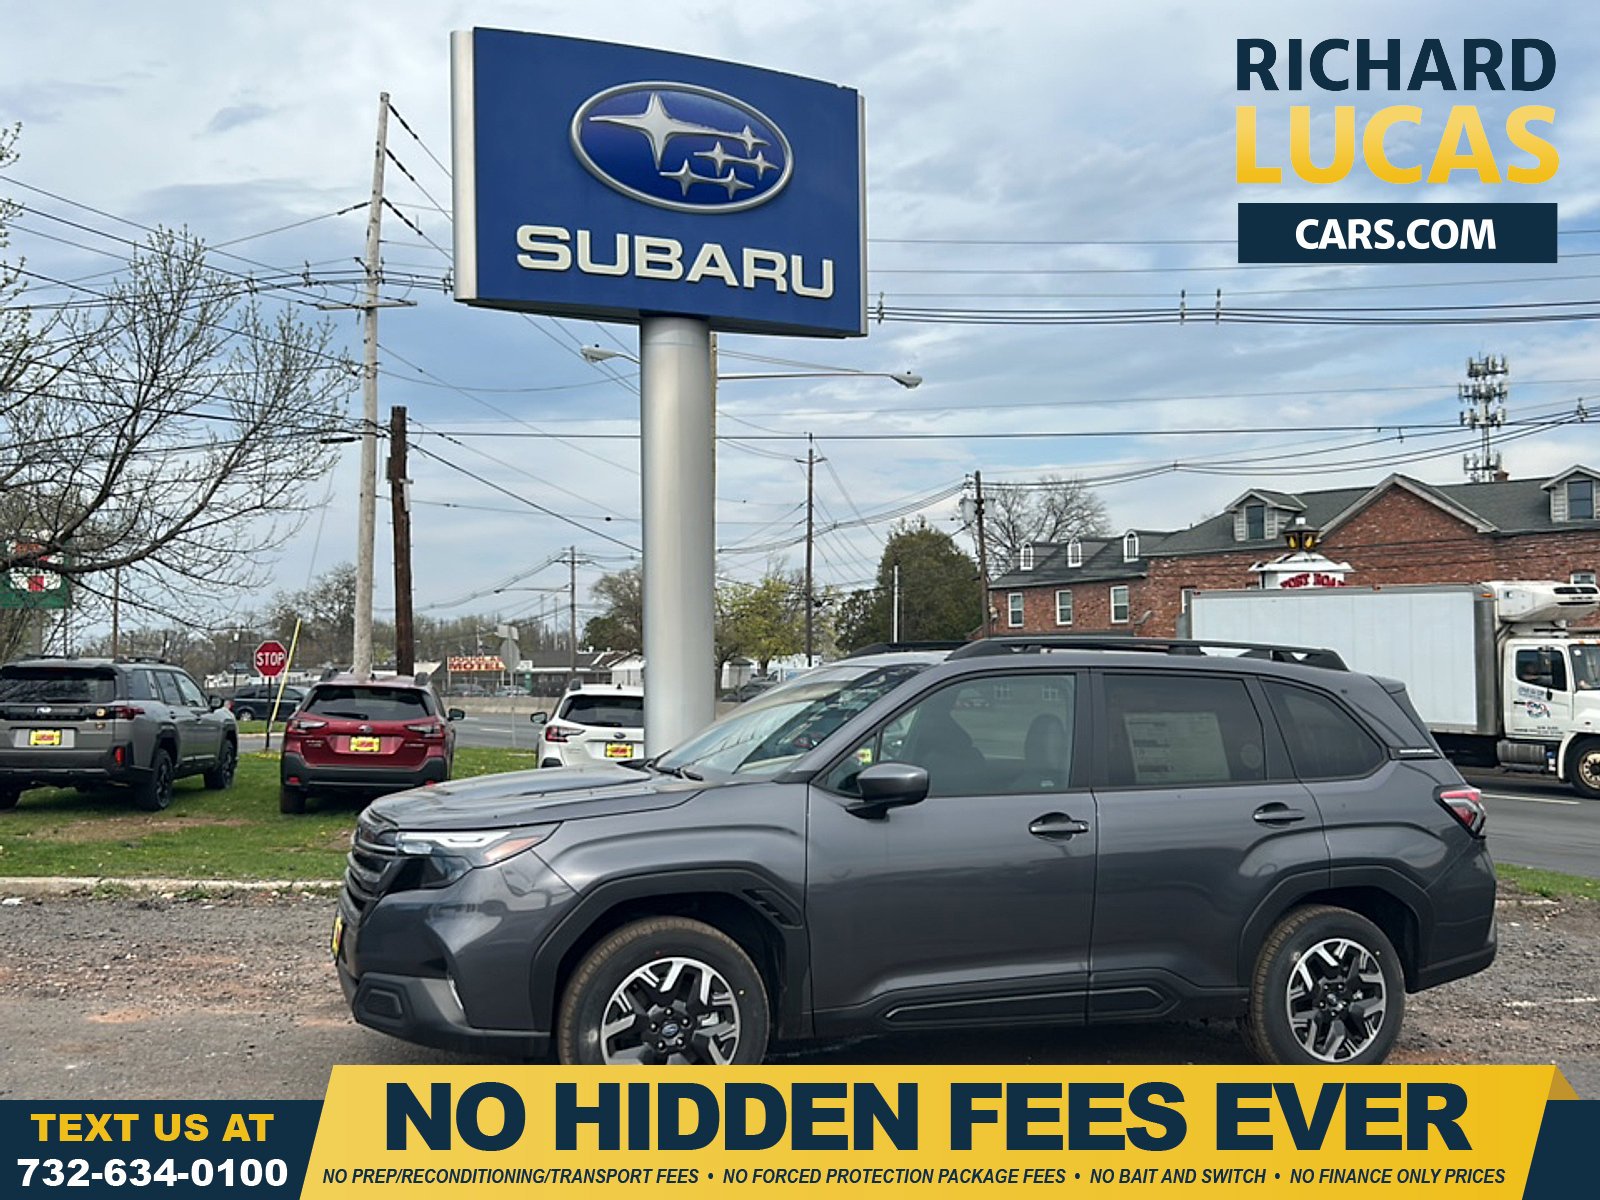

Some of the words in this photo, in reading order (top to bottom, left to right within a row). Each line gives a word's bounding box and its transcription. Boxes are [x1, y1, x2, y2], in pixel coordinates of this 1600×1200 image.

[516, 224, 835, 299] SUBARU
[256, 651, 285, 667] STOP
[448, 662, 501, 670] MOTEL
